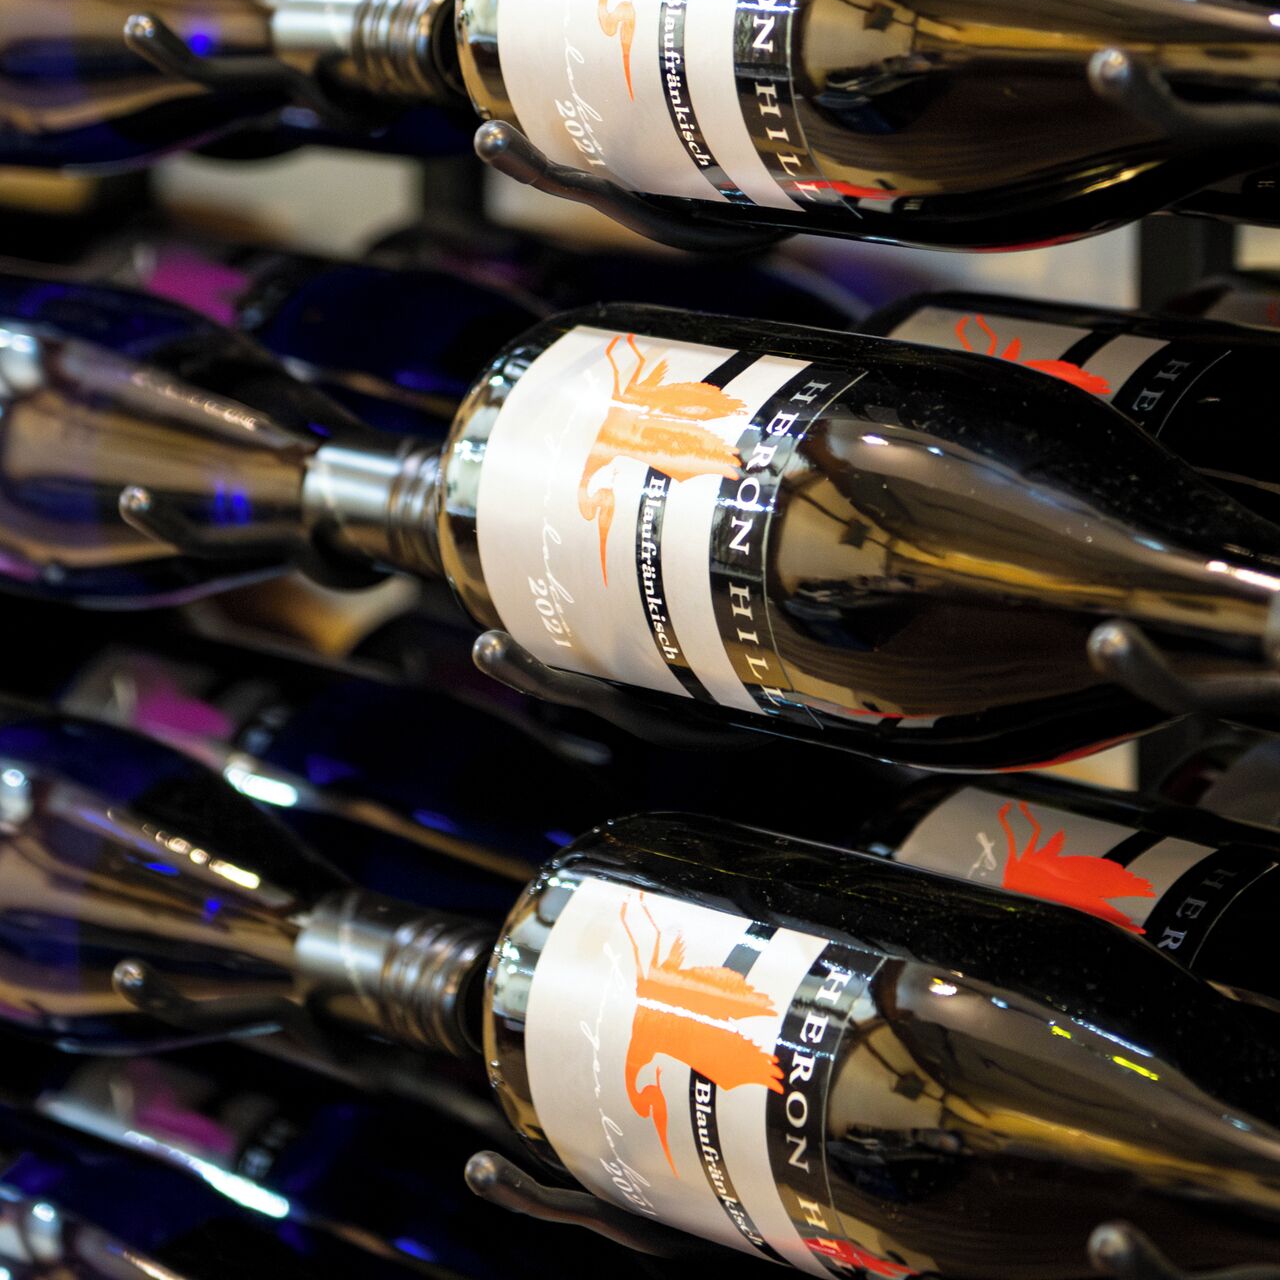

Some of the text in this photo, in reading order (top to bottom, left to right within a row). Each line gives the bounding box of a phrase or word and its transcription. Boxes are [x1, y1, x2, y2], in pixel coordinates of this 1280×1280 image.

[554, 97, 607, 168] 2021
[754, 81, 818, 203] HILL
[527, 575, 572, 649] 2021
[640, 473, 678, 660] Blaufränkisch
[728, 378, 832, 707] HERON HILL
[784, 966, 851, 1175] HERON
[599, 1157, 658, 1216] 2021
[694, 1079, 764, 1247] Blaufränkisch
